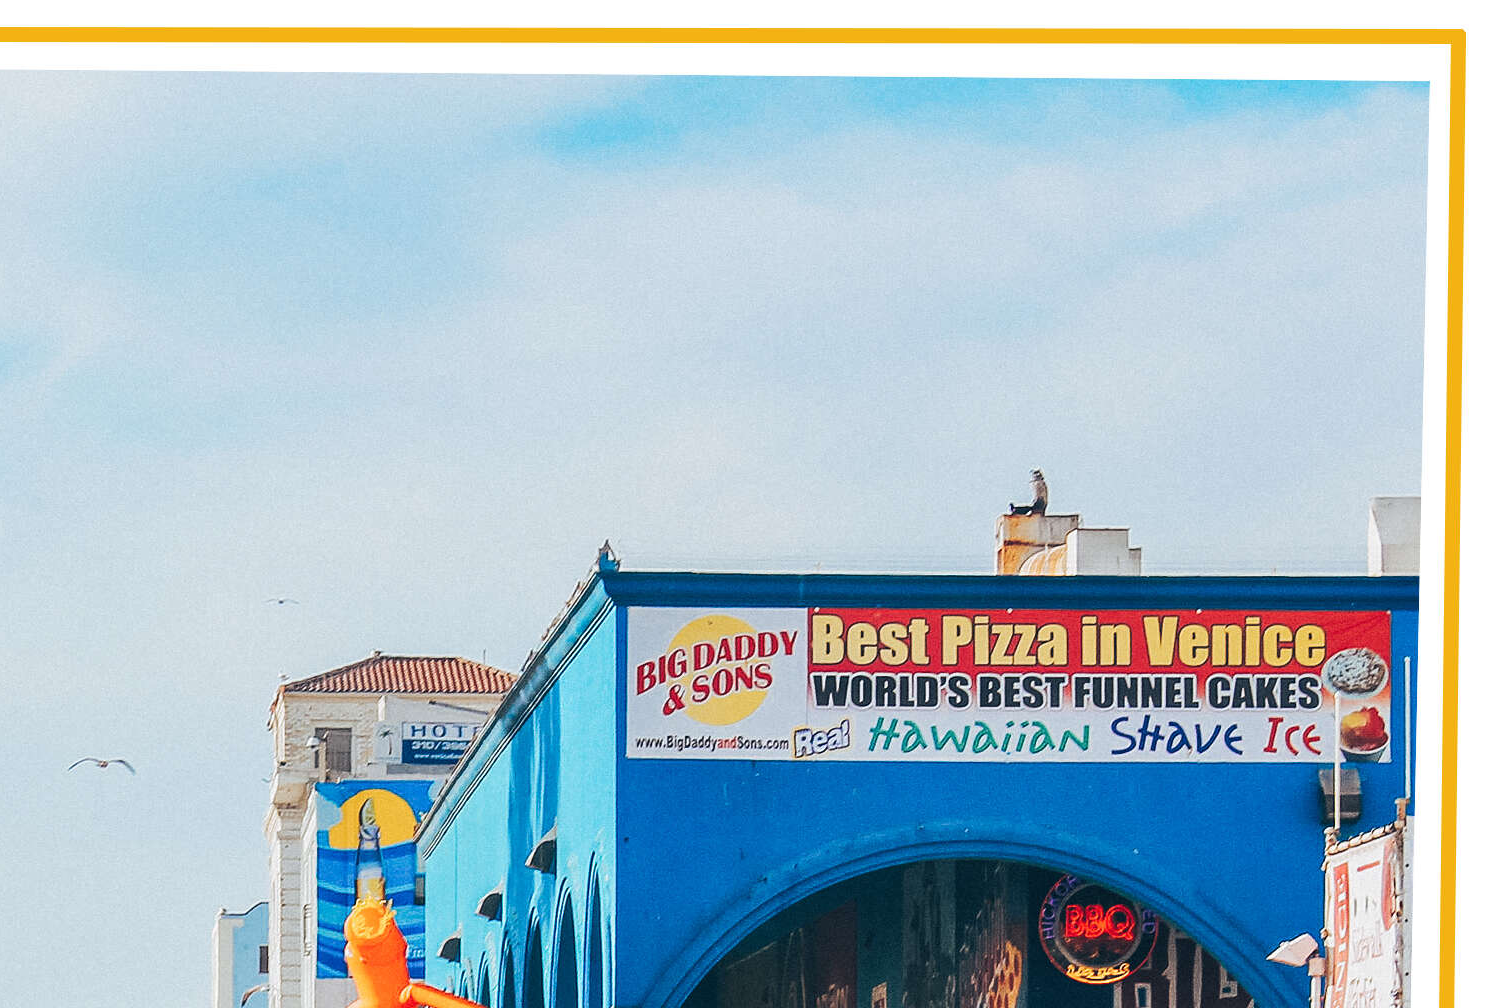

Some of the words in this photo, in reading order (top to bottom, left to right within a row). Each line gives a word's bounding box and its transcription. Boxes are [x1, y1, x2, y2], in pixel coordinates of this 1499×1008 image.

[636, 649, 688, 696] BIG
[693, 630, 798, 671] DADDY
[812, 615, 930, 665] Best
[941, 616, 1069, 666] Pizza
[1081, 616, 1132, 666] in
[1143, 616, 1326, 667] Venice
[662, 684, 686, 716] &
[691, 663, 774, 703] SONS
[813, 675, 969, 708] WORLD'S
[979, 676, 1067, 708] BEST
[1075, 677, 1199, 709] FUNNEL
[1208, 677, 1322, 709] CAKES
[636, 735, 789, 752] www.BigDaddyandSons.com
[1065, 904, 1135, 941] BBQ
